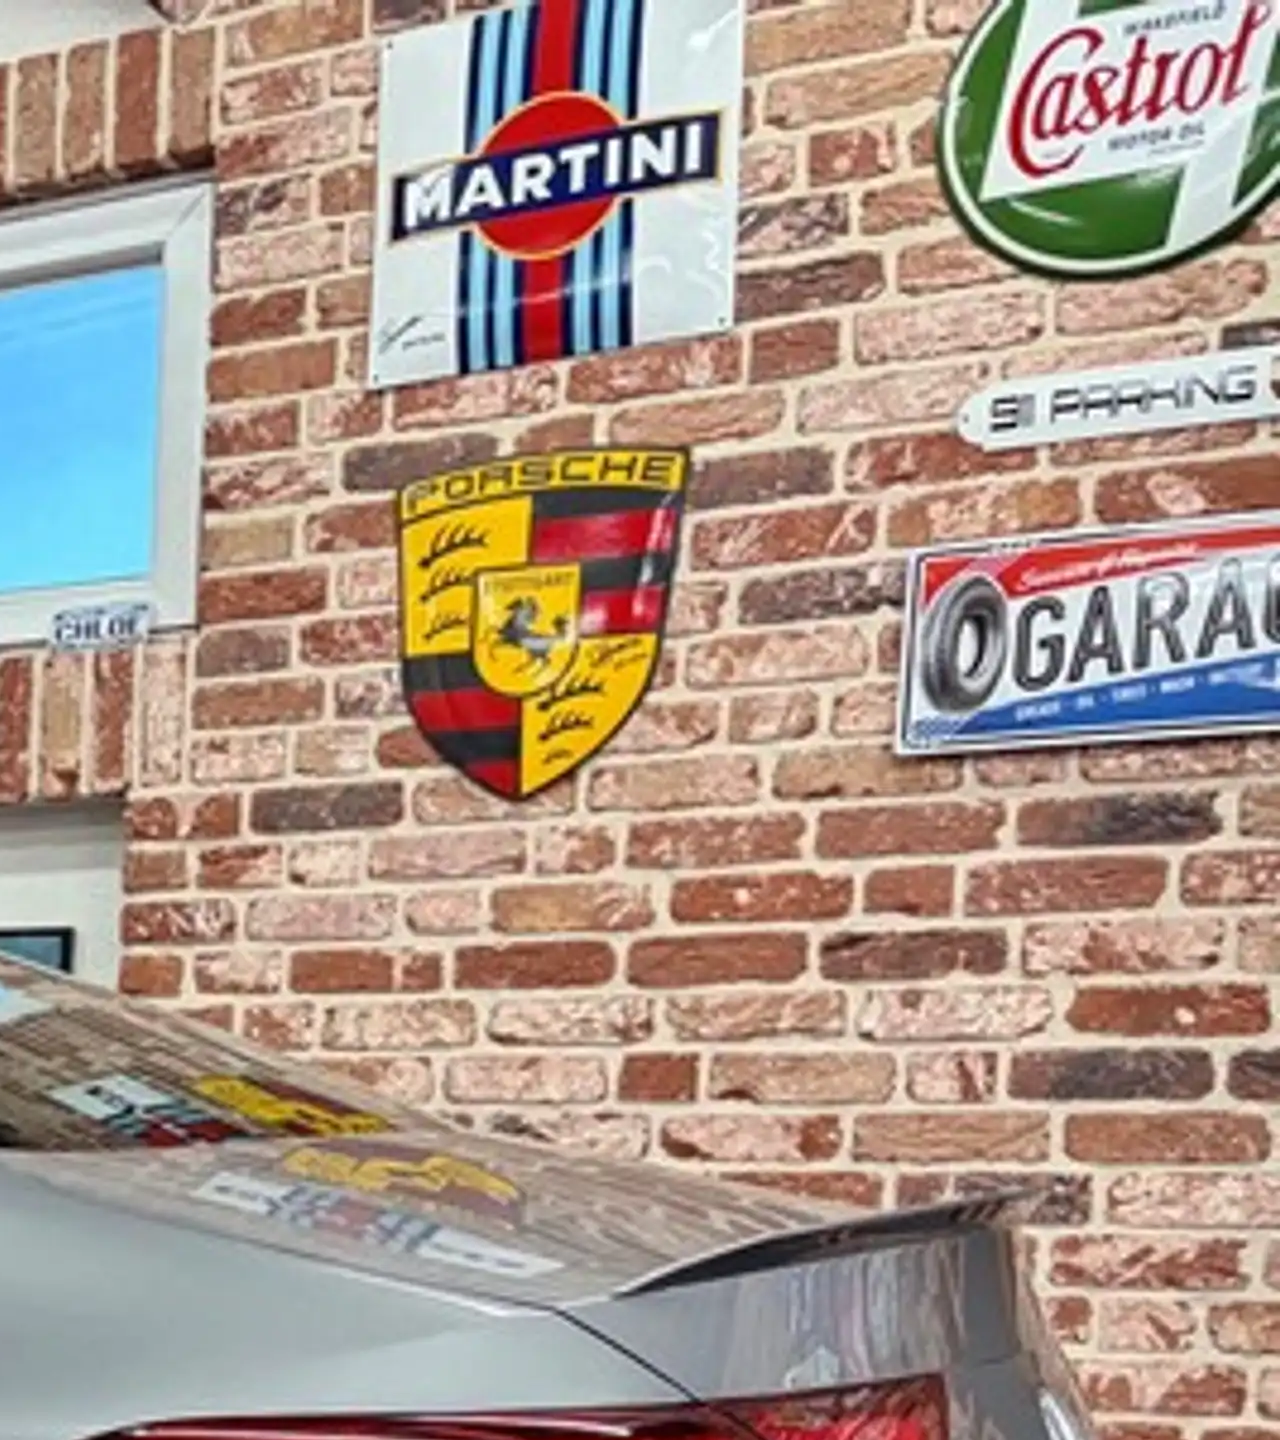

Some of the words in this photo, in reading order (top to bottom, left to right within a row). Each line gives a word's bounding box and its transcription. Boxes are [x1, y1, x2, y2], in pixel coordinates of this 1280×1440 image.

[1008, 2, 1271, 178] Castrol
[404, 121, 702, 228] MARTINI
[1048, 365, 1258, 425] PARKING
[406, 456, 677, 514] PORSCHE
